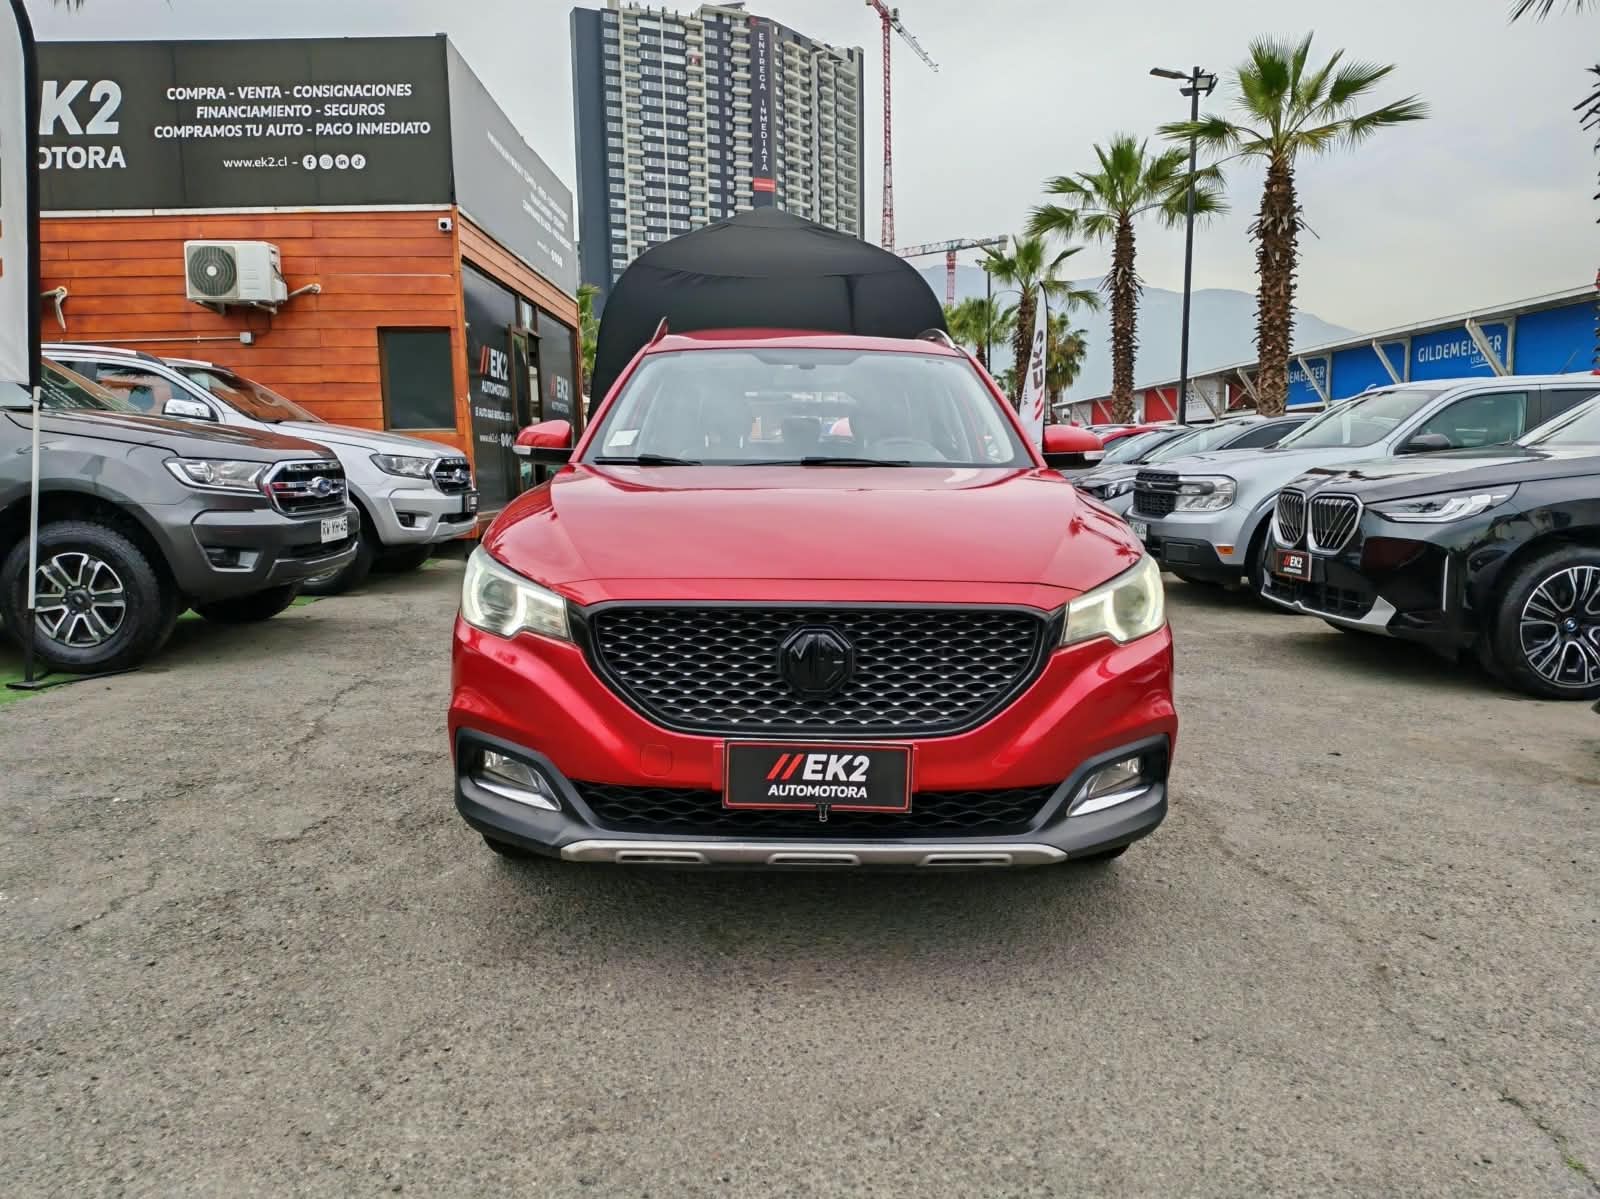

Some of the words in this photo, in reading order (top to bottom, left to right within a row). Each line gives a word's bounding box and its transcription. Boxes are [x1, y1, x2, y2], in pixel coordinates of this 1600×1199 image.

[758, 32, 767, 90] ENTREGA
[166, 87, 226, 101] COMPRA
[238, 86, 281, 99] VENTA
[293, 83, 412, 98] CONSIGNACIONES
[39, 80, 122, 135] K2
[196, 104, 312, 118] FINANCIAMIENTO
[324, 103, 386, 117] SEGUROS
[154, 125, 242, 139] COMPRAMOS
[245, 124, 262, 137] TU
[266, 123, 303, 137] AUTO
[315, 122, 353, 136] PAGO
[357, 121, 431, 135] INMEDIATO
[760, 99, 769, 171] INMEDIATA
[223, 155, 288, 168] www.ek2.cl
[490, 347, 508, 381] EK2
[767, 784, 868, 798] AUTOMOTORA
